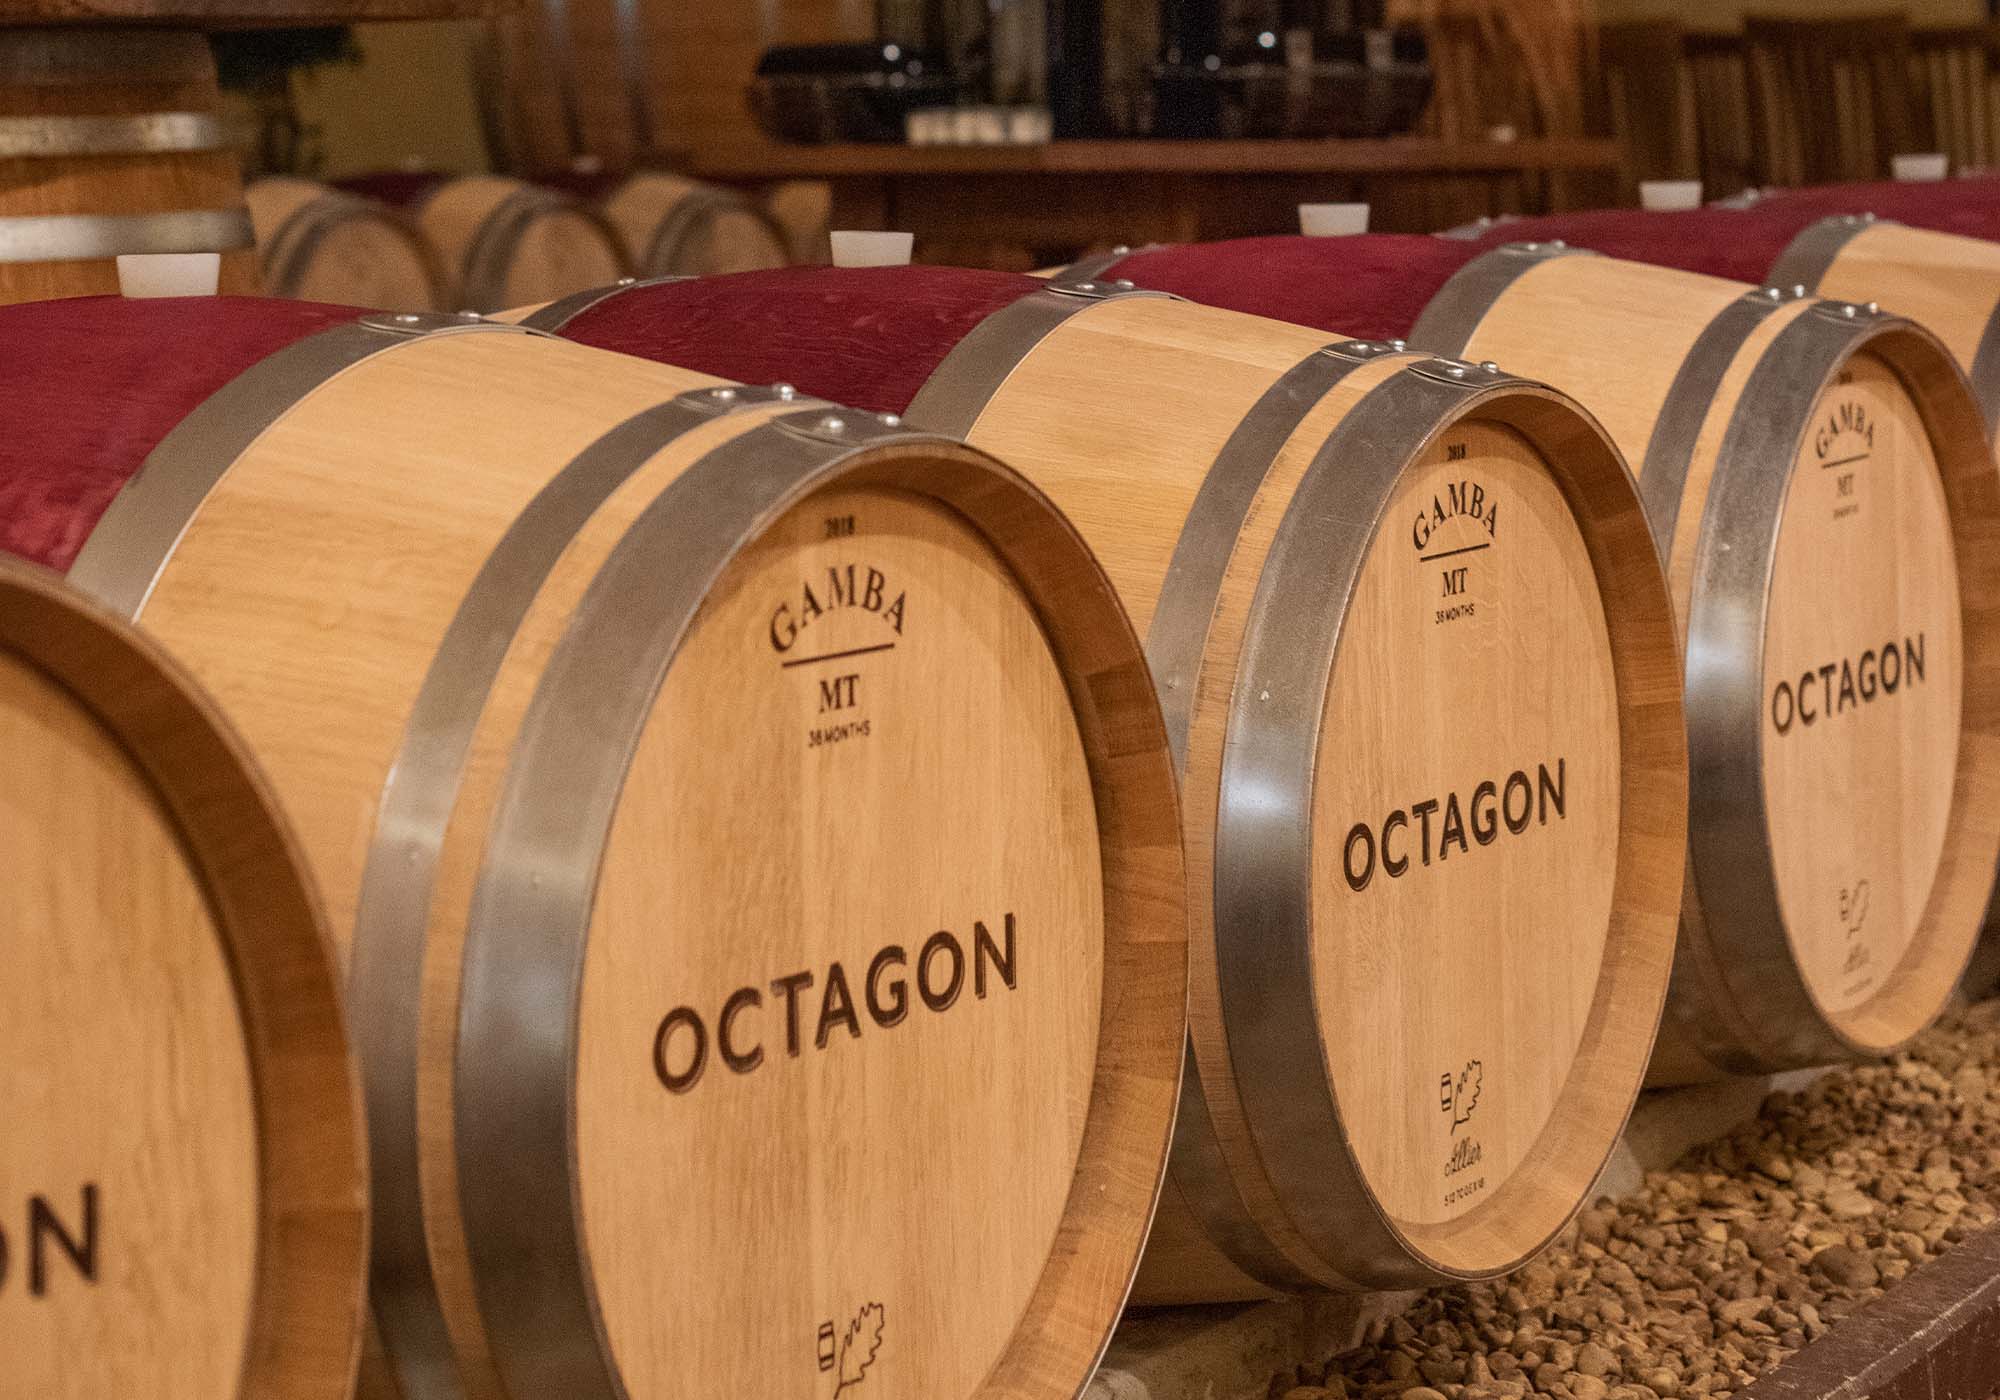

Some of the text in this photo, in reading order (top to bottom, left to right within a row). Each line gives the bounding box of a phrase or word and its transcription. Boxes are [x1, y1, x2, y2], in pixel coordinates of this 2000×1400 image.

[1412, 480, 1498, 551] GAMBA
[769, 564, 907, 653] GAMBA
[1442, 568, 1468, 597] MT
[1445, 603, 1475, 621] MONTHS
[818, 674, 860, 715] MT
[1772, 632, 1925, 737] OCTAGON
[823, 719, 872, 744] MONTHS
[1343, 757, 1566, 892] OCTAGON
[652, 912, 1017, 1095] OCTAGON
